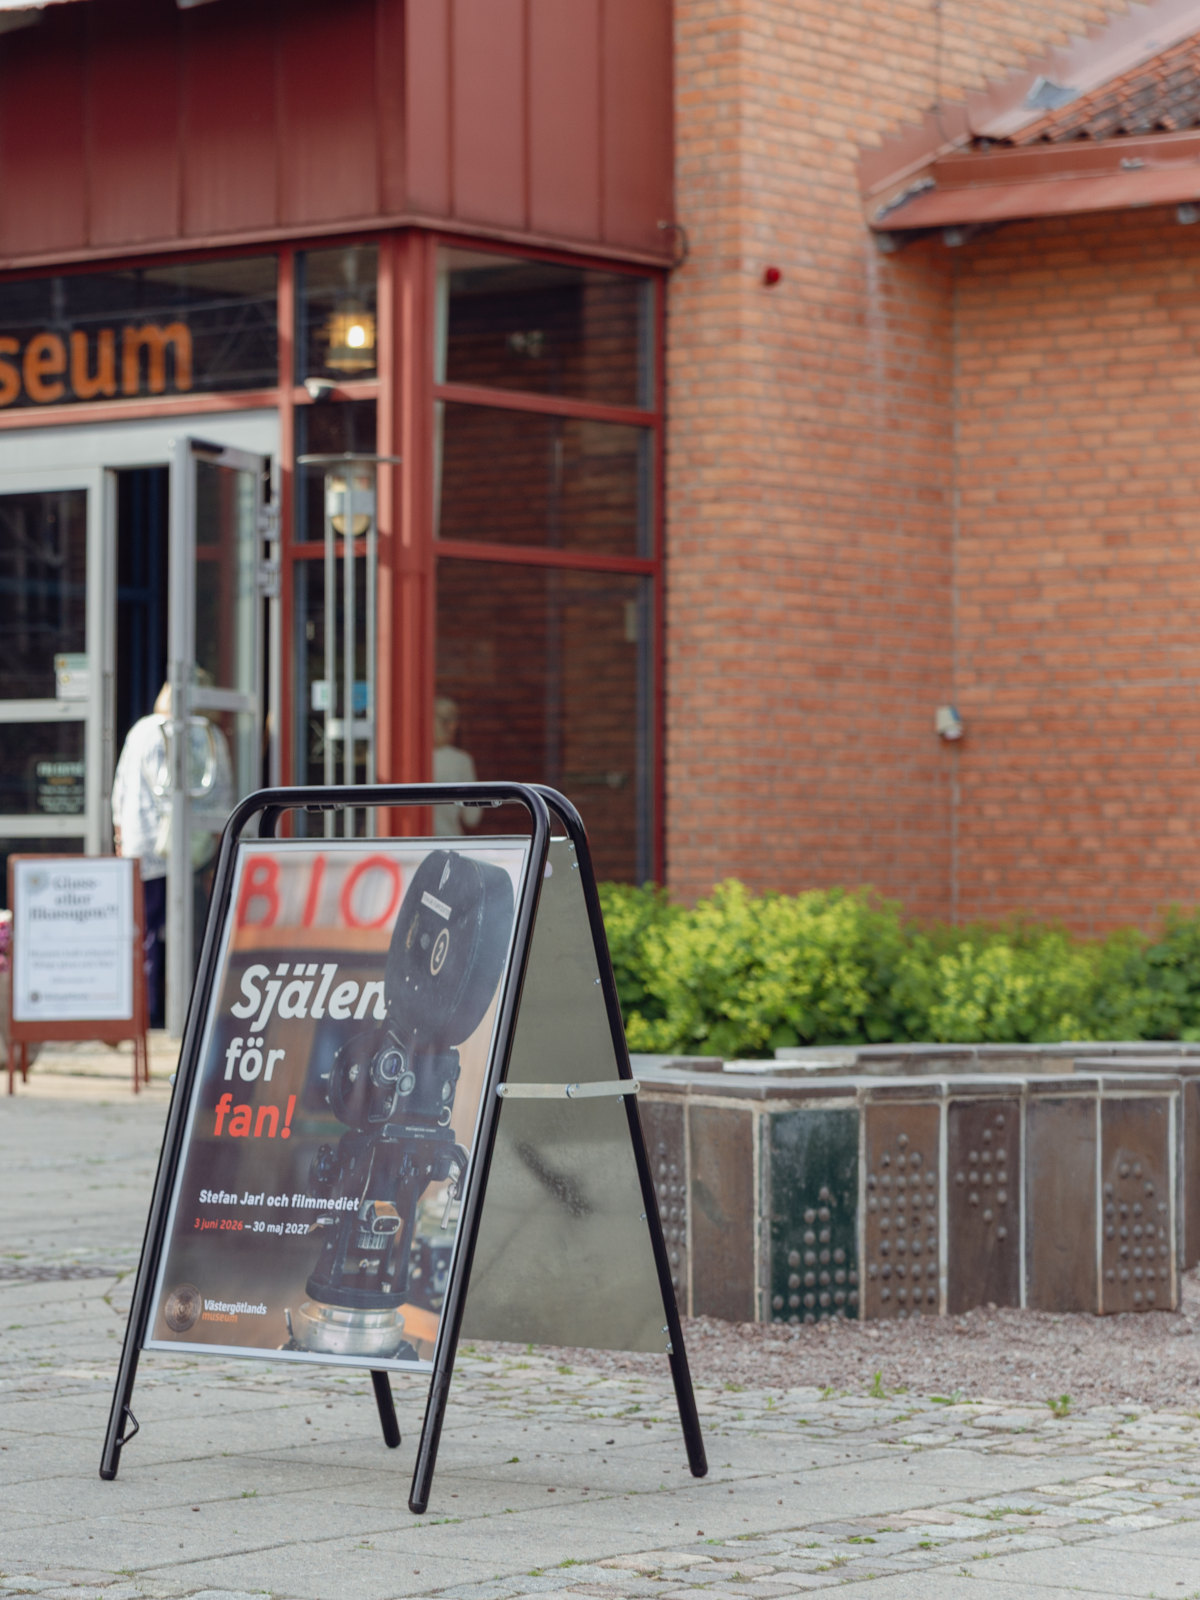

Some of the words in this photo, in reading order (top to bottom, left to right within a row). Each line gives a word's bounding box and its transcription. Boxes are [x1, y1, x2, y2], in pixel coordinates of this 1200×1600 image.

[237, 853, 403, 930] BIO
[230, 963, 388, 1032] Själen
[224, 1037, 286, 1082] för
[213, 1093, 297, 1139] fan!
[199, 1189, 238, 1205] Stefan
[240, 1192, 265, 1206] Jarl
[267, 1194, 289, 1208] och
[291, 1193, 360, 1211] filmmediet
[194, 1217, 201, 1229] 3
[200, 1218, 219, 1231] juni
[220, 1219, 243, 1231] 2026
[253, 1221, 266, 1233] 30
[267, 1223, 284, 1236] maj
[285, 1222, 310, 1235] 2027
[202, 1312, 238, 1323] museum
[204, 1299, 268, 1316] Västergötlands
